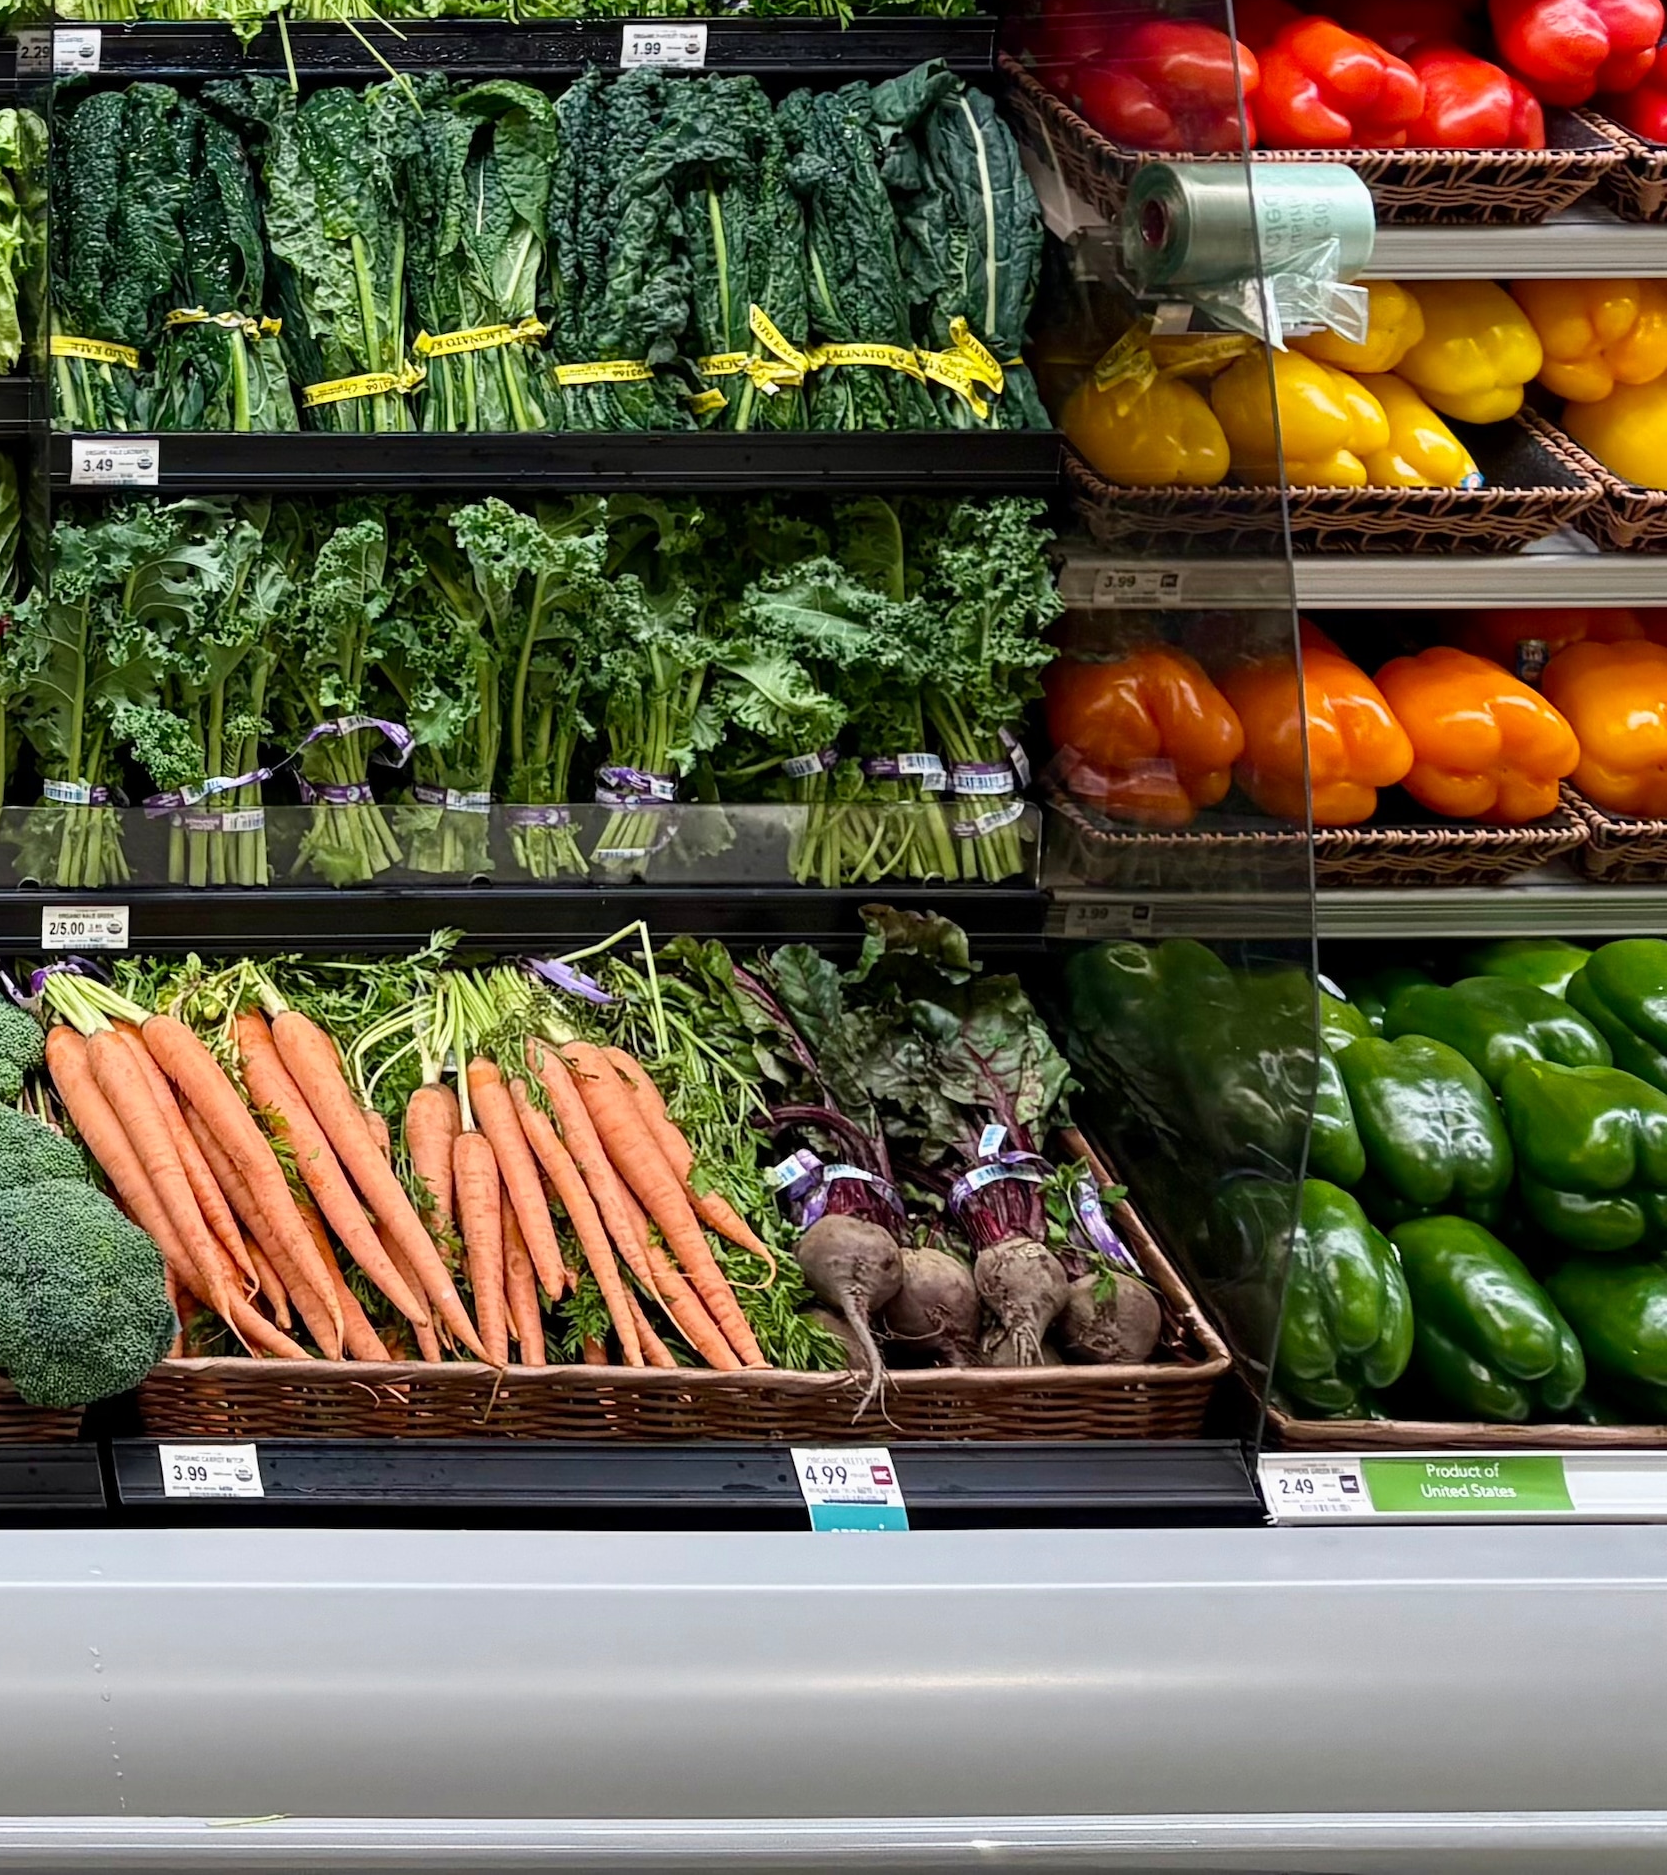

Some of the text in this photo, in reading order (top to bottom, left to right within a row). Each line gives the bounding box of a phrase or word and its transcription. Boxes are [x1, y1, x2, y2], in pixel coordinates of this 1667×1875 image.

[632, 41, 662, 55] 1.99
[81, 458, 114, 473] 3.49
[48, 921, 86, 936] 2/5.00
[172, 1464, 208, 1482] 3.99
[804, 1465, 849, 1485] 4.99
[1425, 1462, 1501, 1479] Product of
[1278, 1478, 1315, 1494] 2.49
[1420, 1483, 1518, 1499] United States
